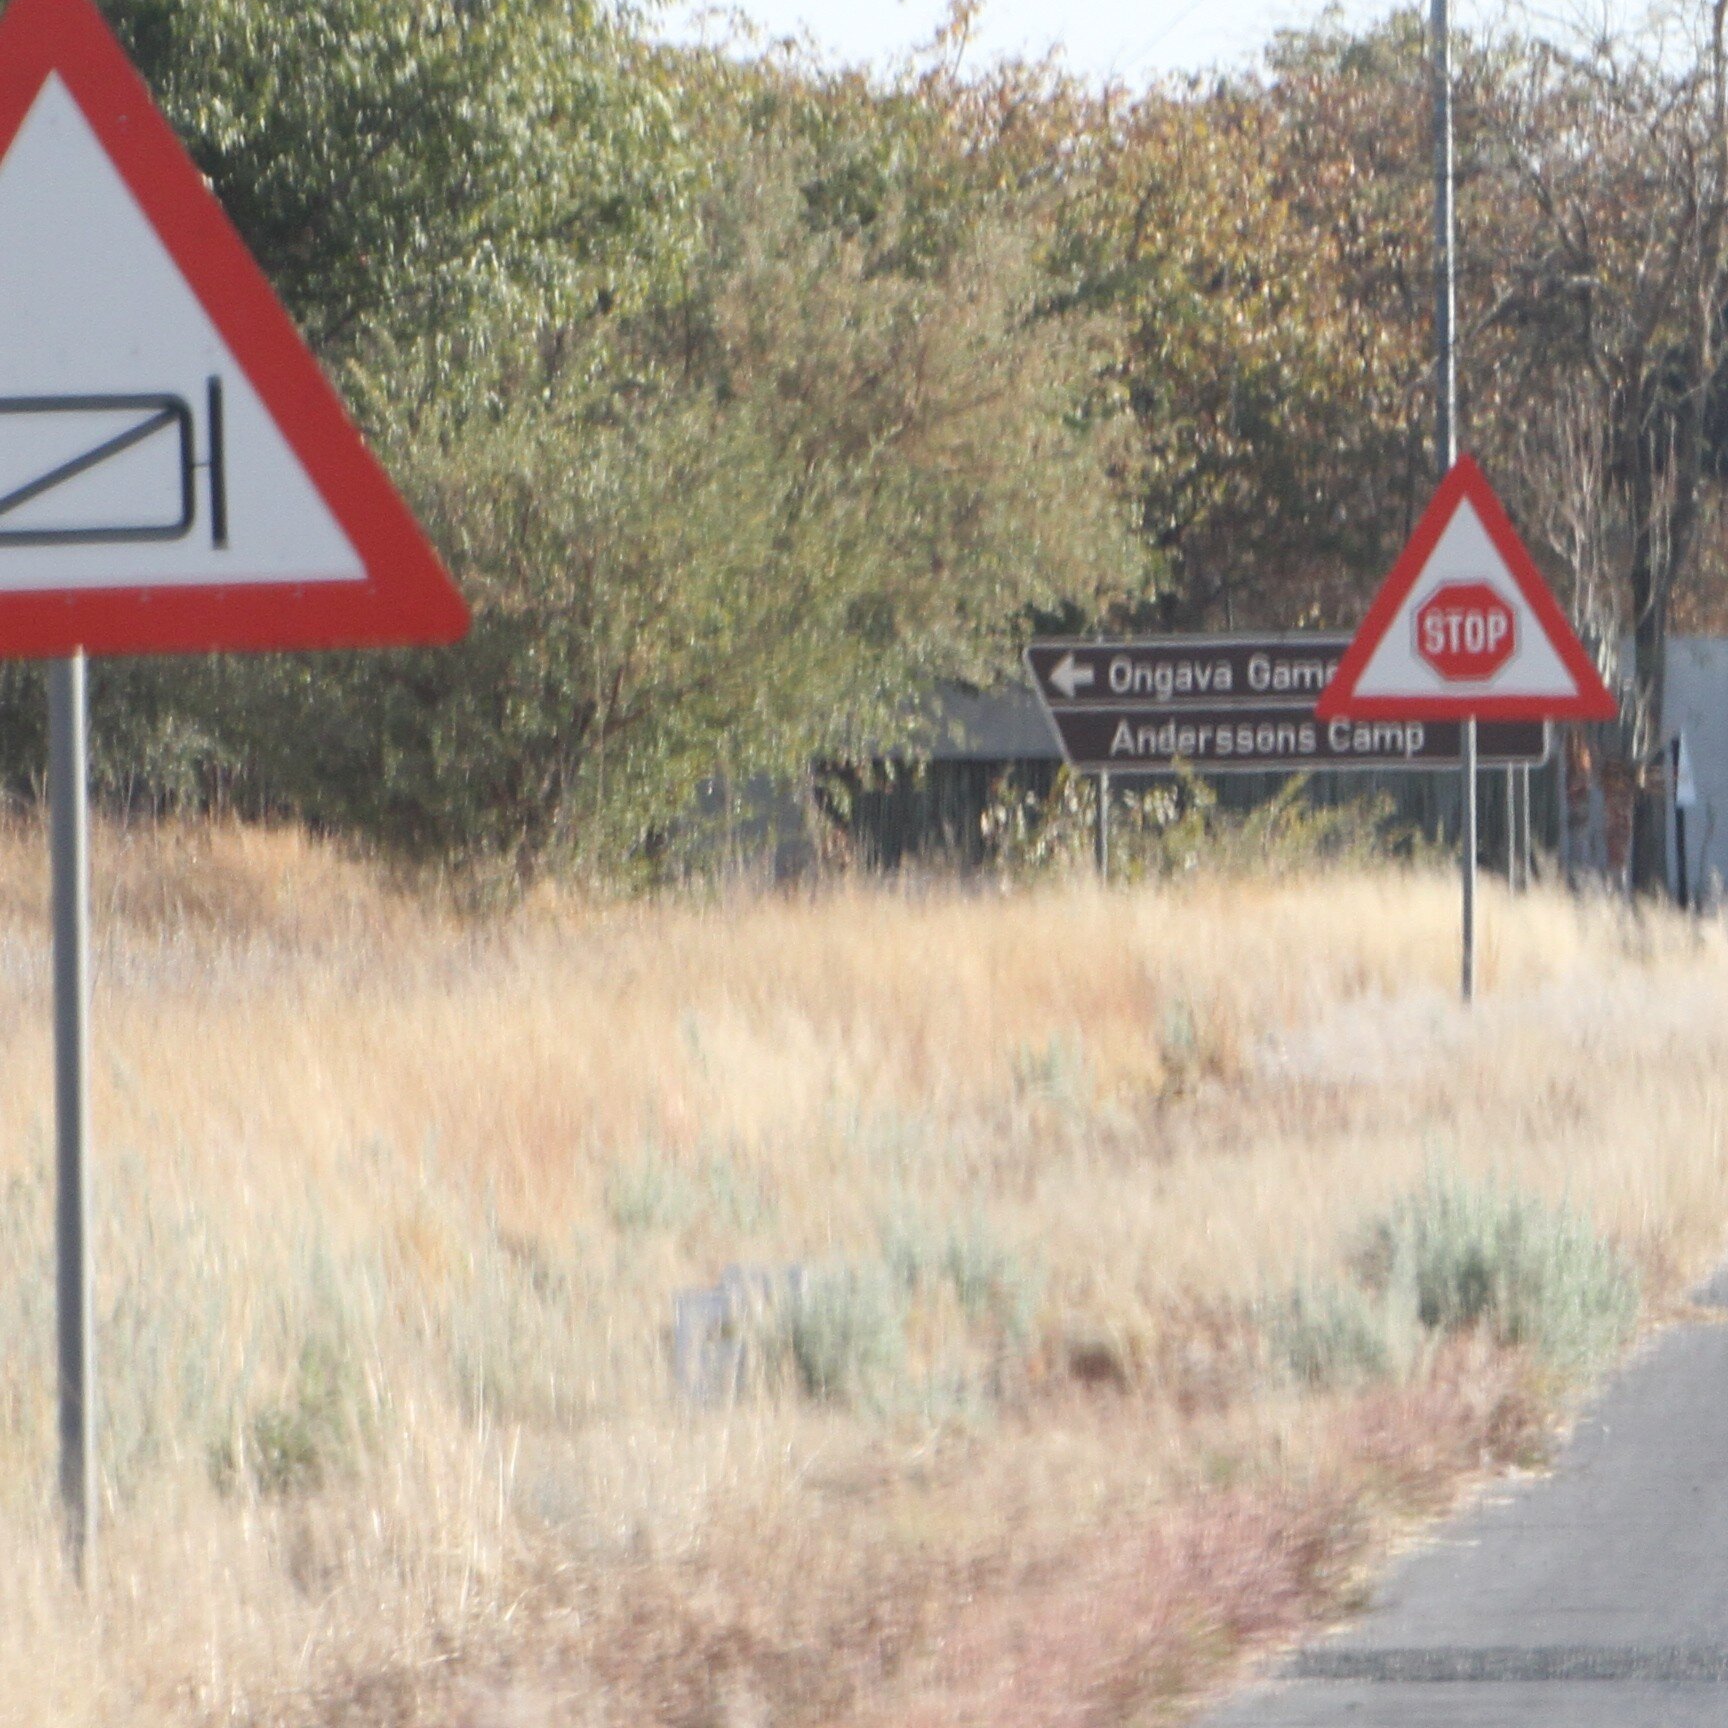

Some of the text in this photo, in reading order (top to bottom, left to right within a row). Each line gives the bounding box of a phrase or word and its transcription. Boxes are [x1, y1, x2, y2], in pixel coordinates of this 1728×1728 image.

[1423, 607, 1507, 654] STOP
[1109, 653, 1233, 702] Ongava
[1110, 716, 1425, 759] Anderssons Camp
